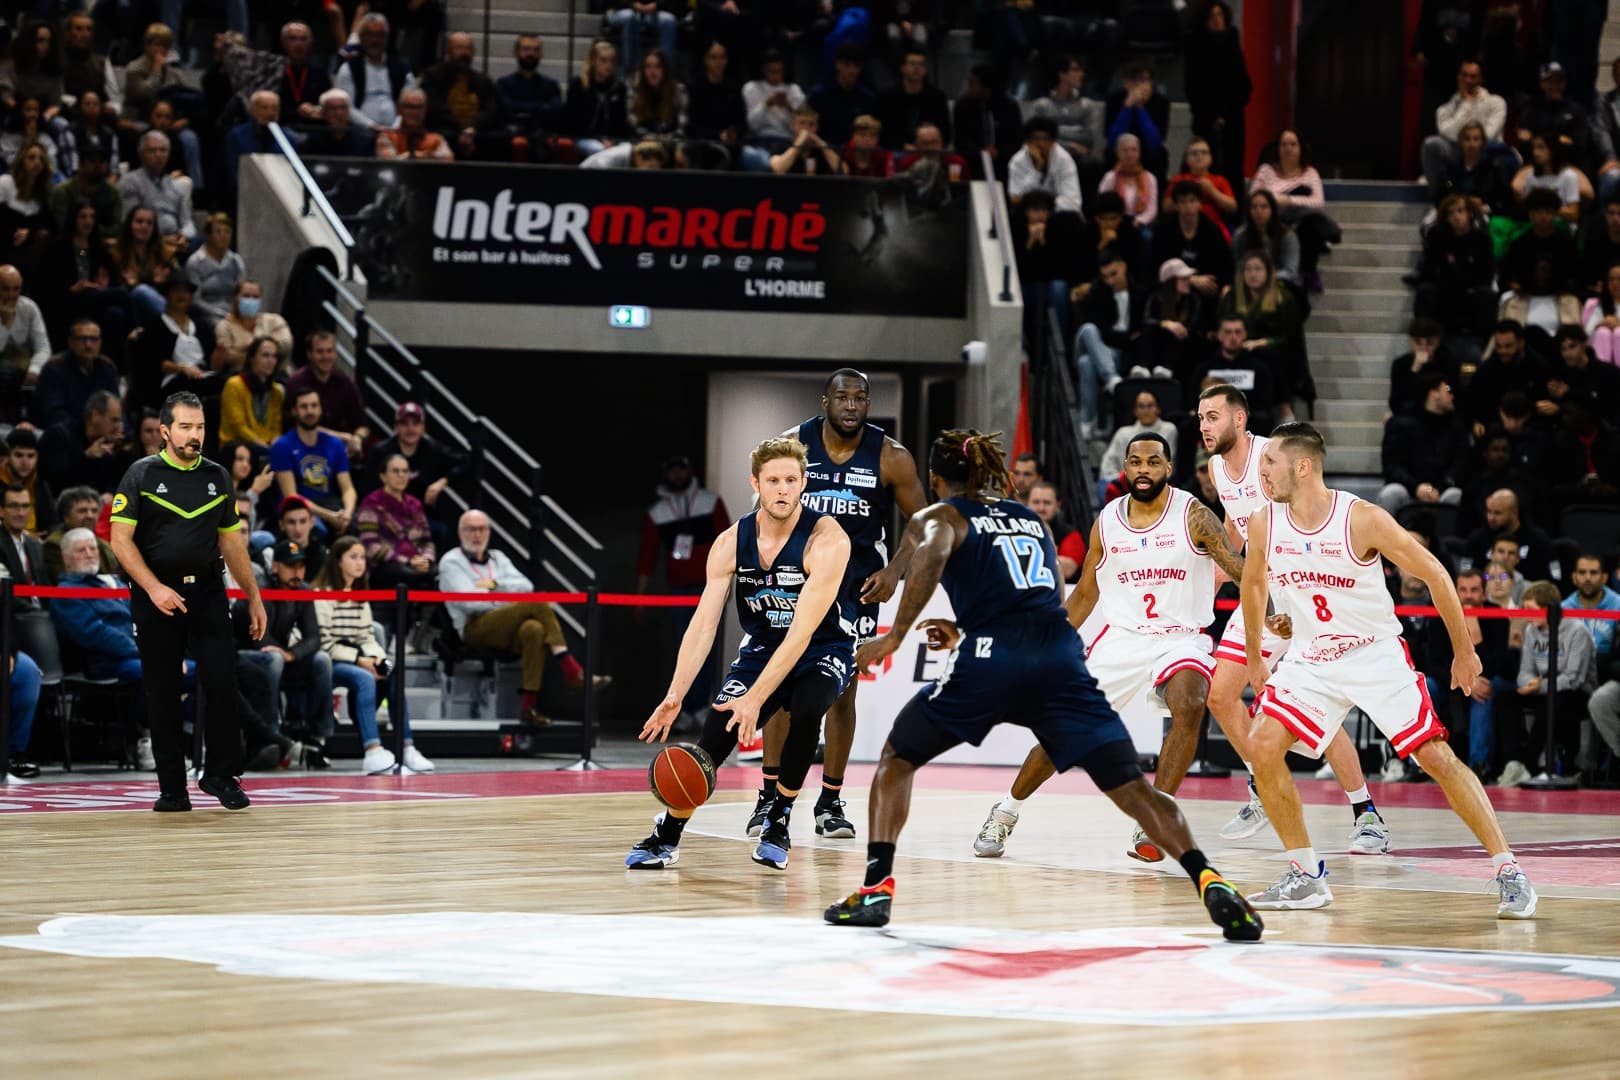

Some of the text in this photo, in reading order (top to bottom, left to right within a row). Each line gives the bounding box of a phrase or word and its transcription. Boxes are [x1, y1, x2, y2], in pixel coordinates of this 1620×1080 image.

[433, 247, 449, 262] Et
[452, 250, 478, 263] son
[481, 249, 505, 264] bar
[745, 279, 826, 298] L'HORME
[800, 493, 871, 517] ANTIBES
[970, 516, 1044, 539] POLLARD
[992, 535, 1055, 590] 12
[1117, 571, 1129, 584] ST
[1130, 568, 1187, 581] CHAMOND
[1290, 571, 1356, 589] CHAMOND
[1143, 593, 1159, 619] 2
[1312, 594, 1333, 622] 8
[975, 637, 994, 658] 12
